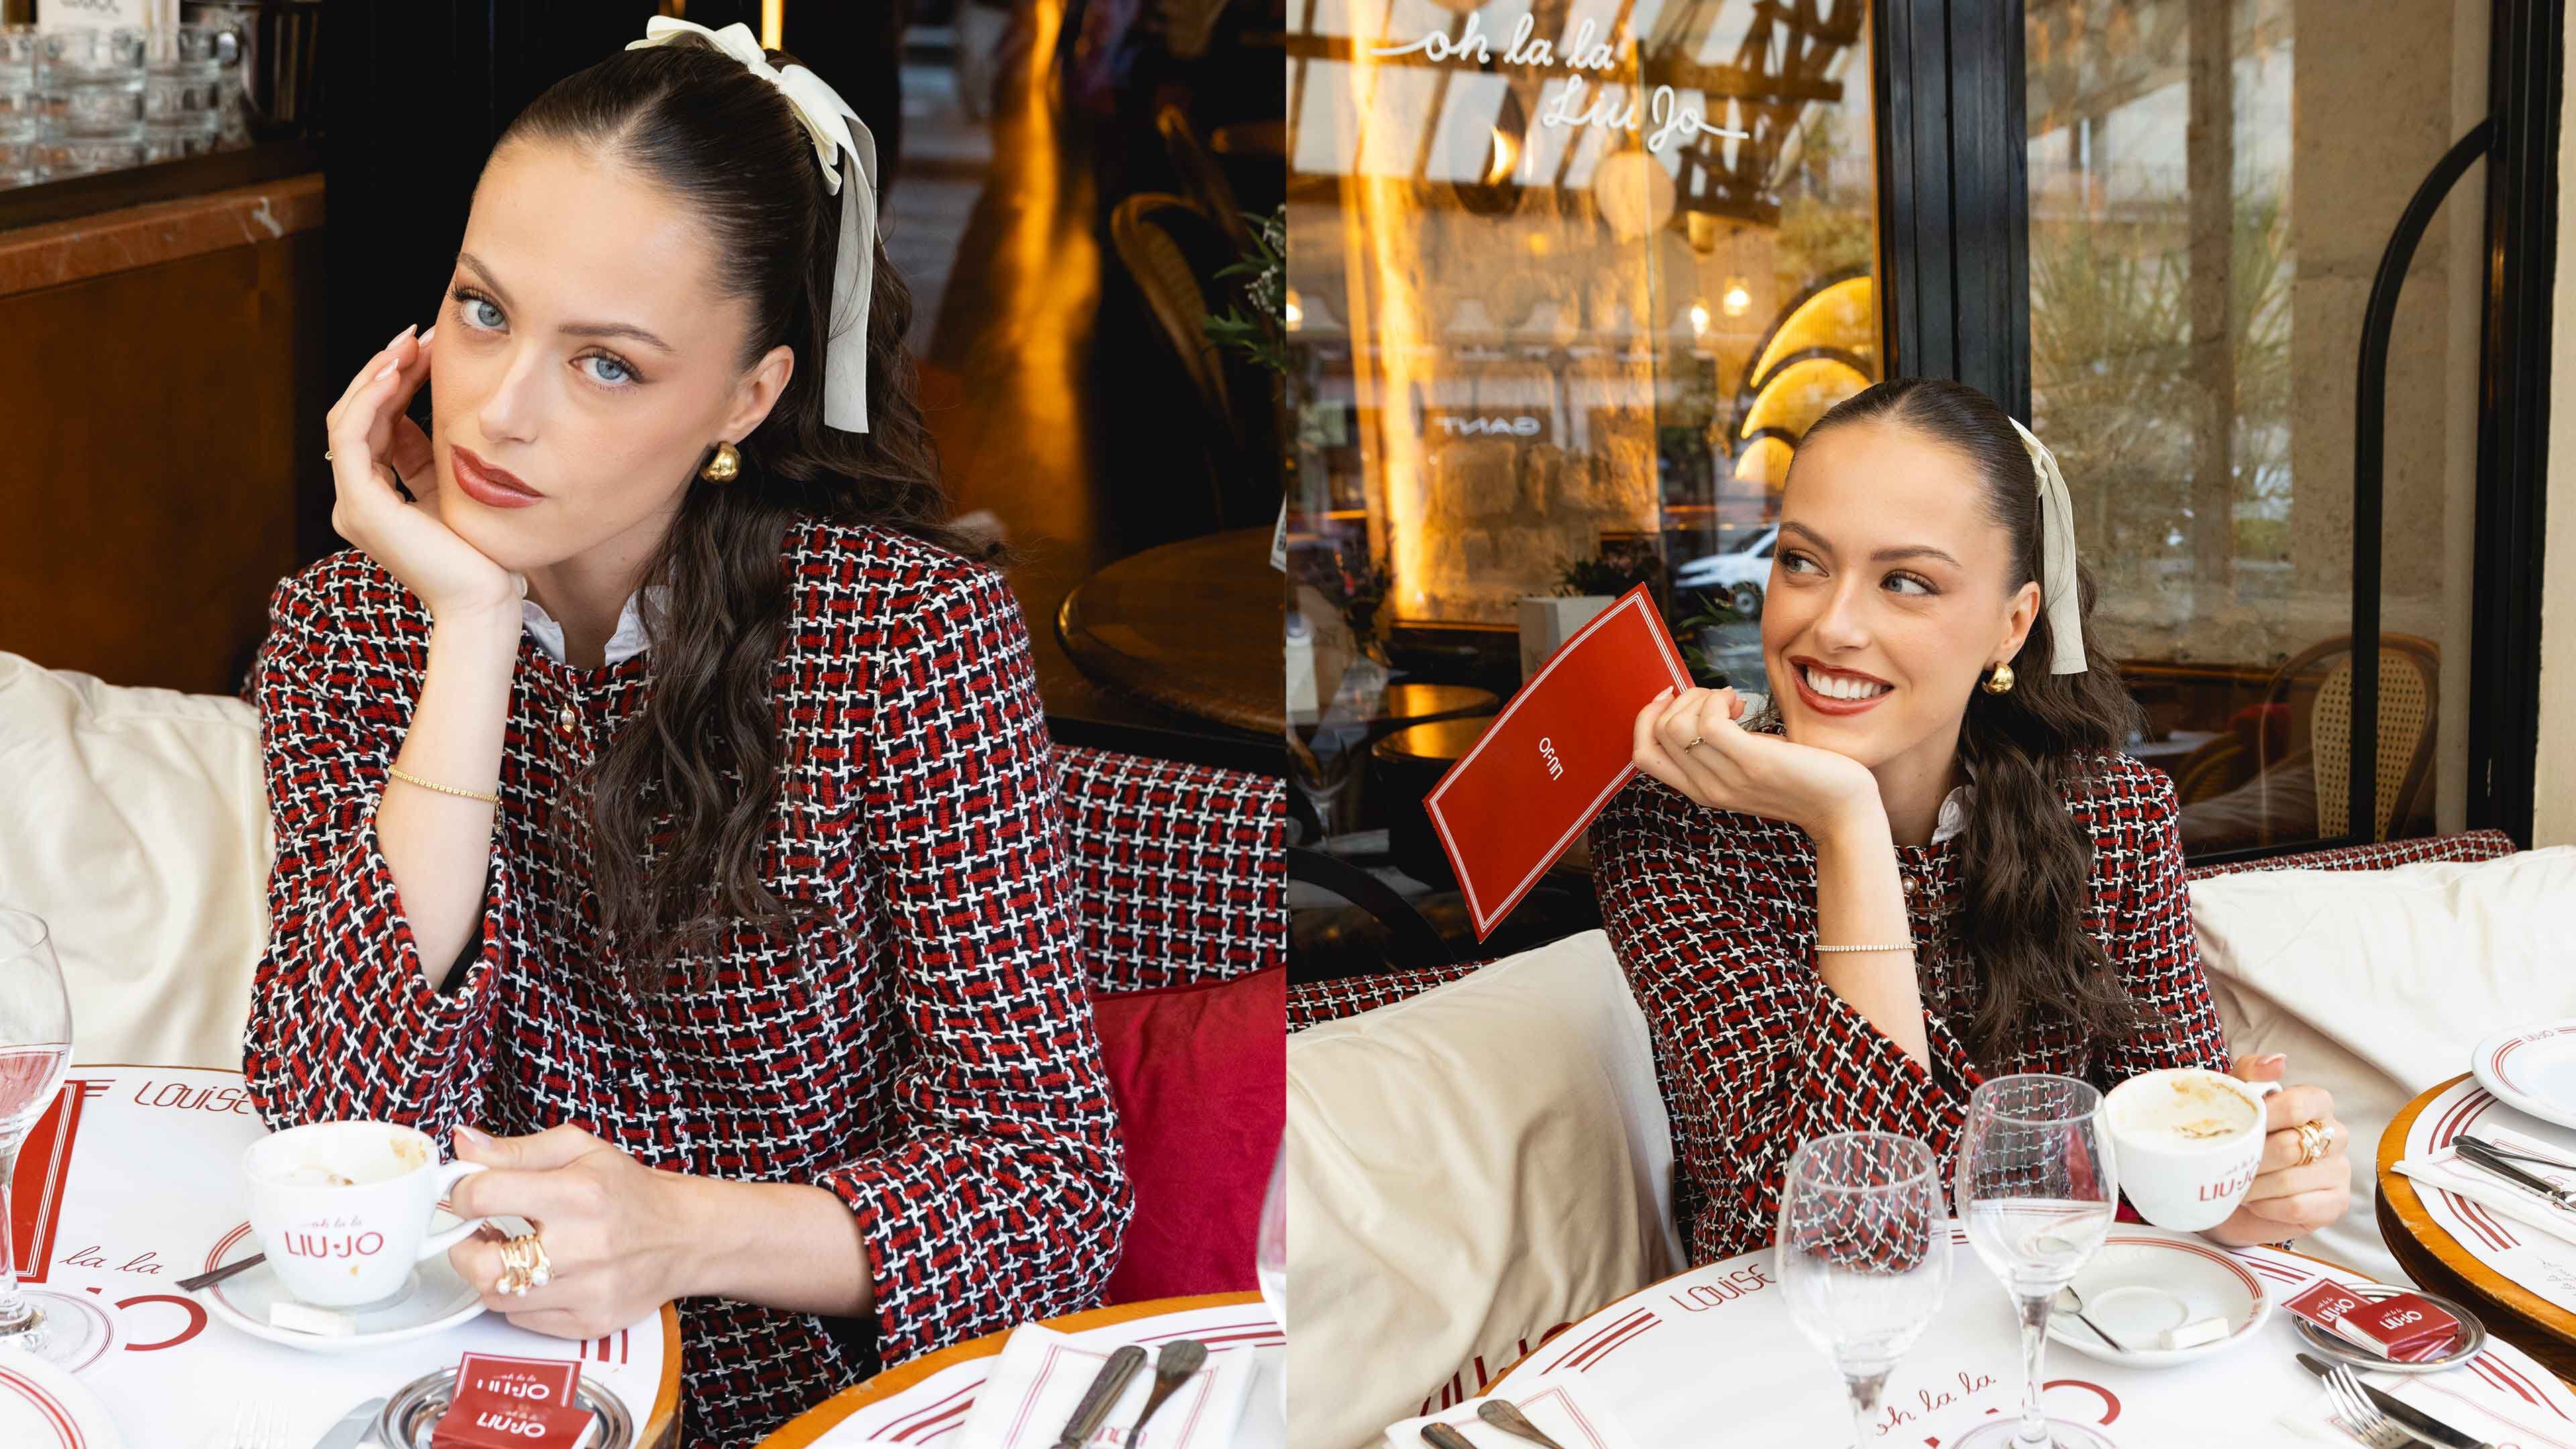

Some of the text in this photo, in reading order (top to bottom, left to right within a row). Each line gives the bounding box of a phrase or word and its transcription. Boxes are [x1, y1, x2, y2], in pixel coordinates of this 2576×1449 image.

[1370, 11, 1615, 70] oh la la
[1542, 74, 1750, 152] Liu Jo
[59, 1246, 163, 1274] la la
[1919, 1390, 1957, 1412] la
[1959, 1371, 1996, 1395] la
